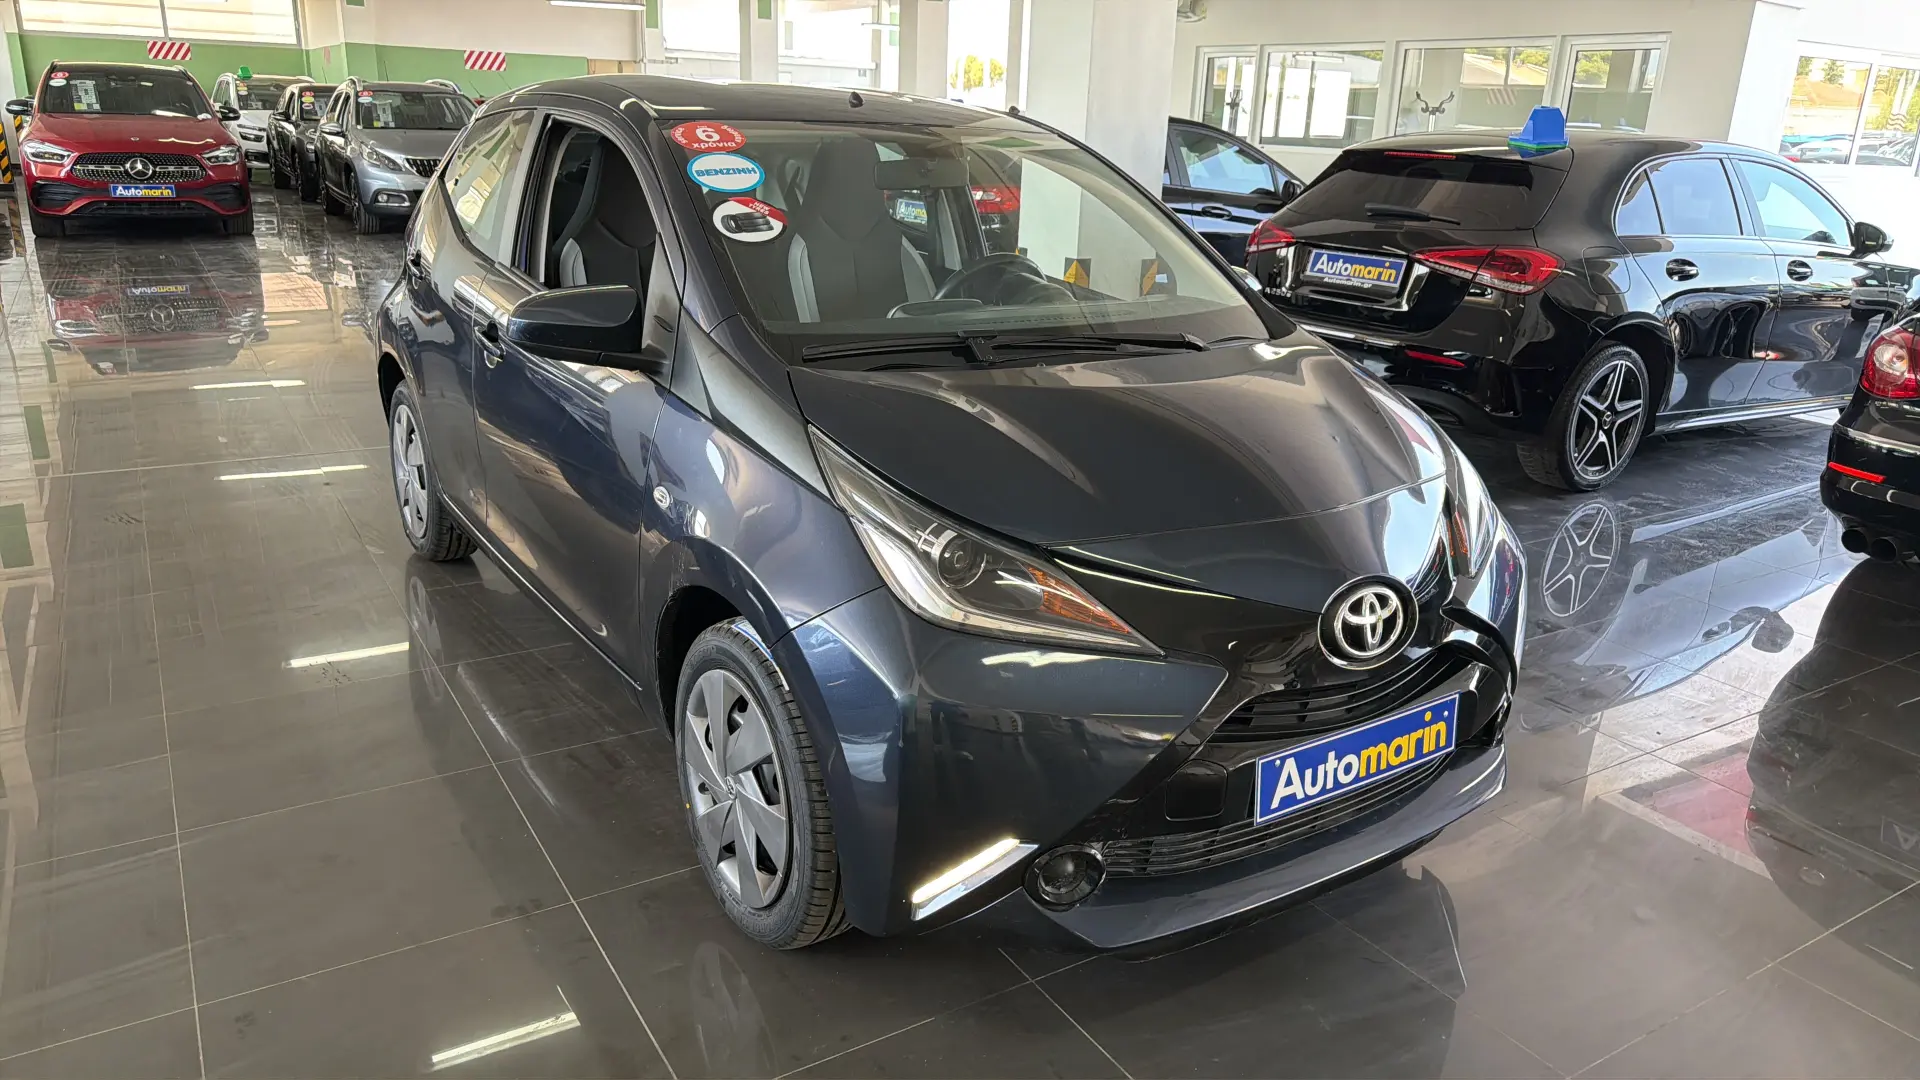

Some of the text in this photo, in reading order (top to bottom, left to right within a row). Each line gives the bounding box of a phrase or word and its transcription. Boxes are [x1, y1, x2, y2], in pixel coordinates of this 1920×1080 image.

[695, 127, 720, 142] 6
[692, 140, 736, 149] χρόνια
[116, 186, 172, 196] Automarin
[900, 202, 927, 217] Automa
[1313, 254, 1397, 282] Automarin
[1323, 277, 1373, 289] Automarin.gr
[1270, 711, 1447, 810] Automarin
